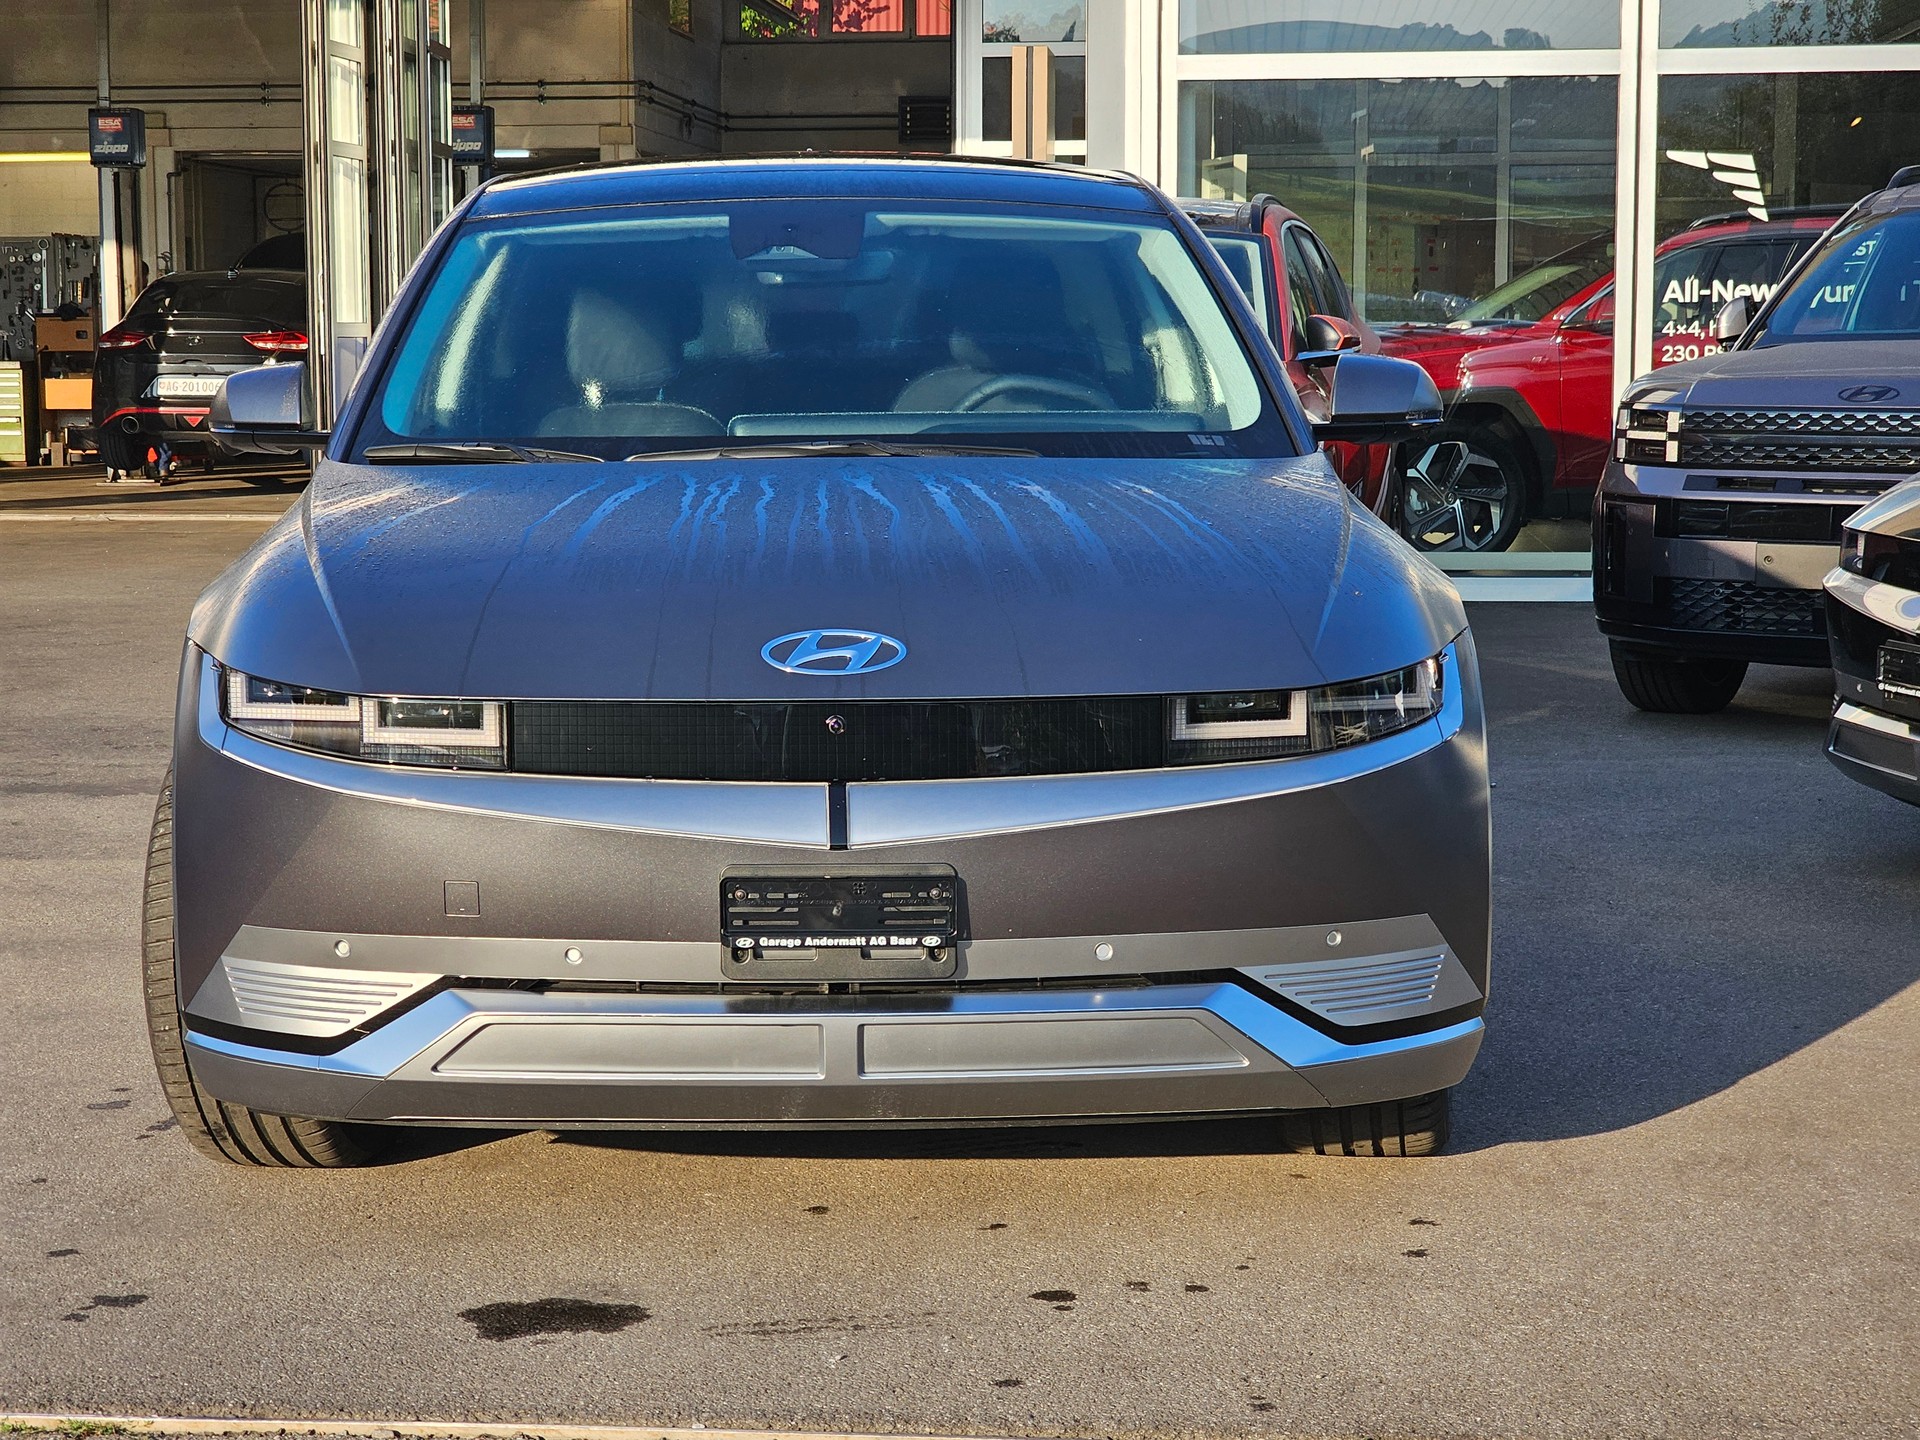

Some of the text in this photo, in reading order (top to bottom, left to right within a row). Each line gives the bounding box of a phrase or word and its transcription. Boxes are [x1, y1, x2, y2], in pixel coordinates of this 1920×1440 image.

[1661, 345, 1699, 362] 230
[759, 936, 918, 948] Garage Andermatt AG Baar
